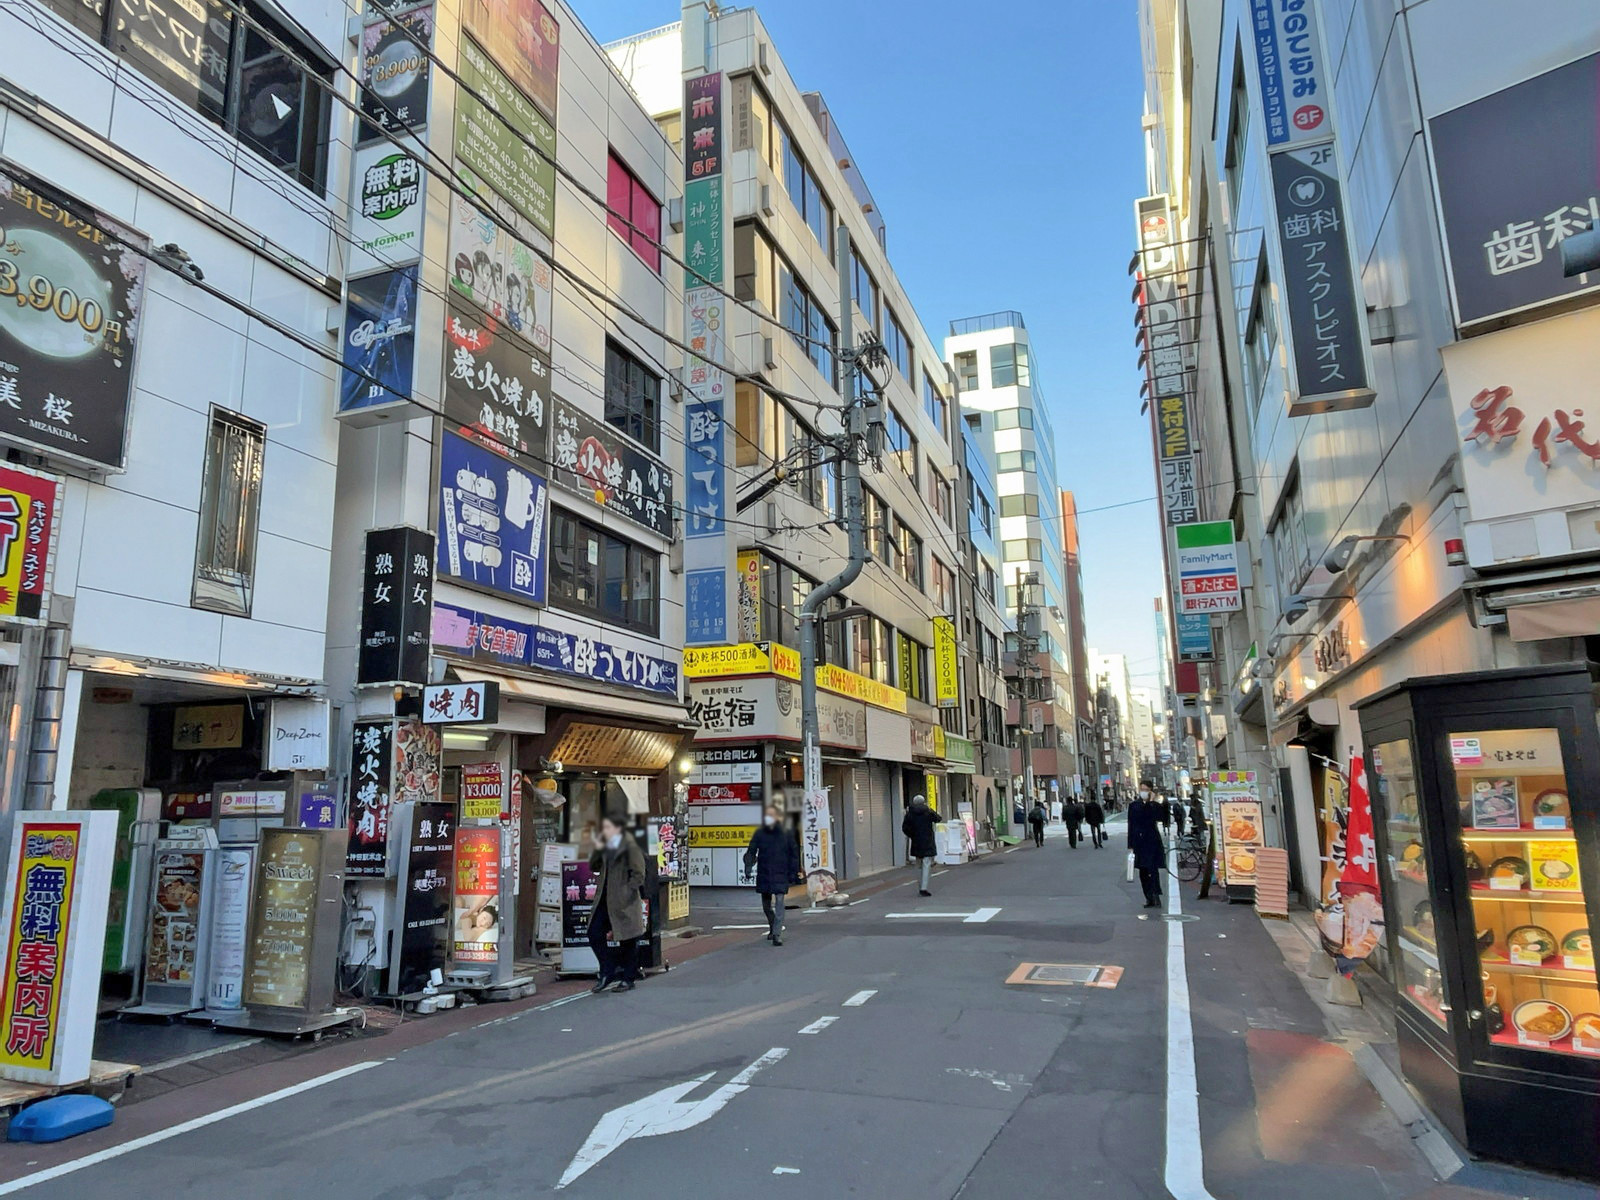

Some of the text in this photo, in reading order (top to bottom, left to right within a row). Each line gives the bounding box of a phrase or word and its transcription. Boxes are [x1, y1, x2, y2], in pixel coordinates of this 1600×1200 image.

[1296, 109, 1320, 126] 3F
[459, 140, 477, 164] TEL
[1310, 148, 1333, 166] 2F
[365, 158, 419, 194] 無料
[362, 185, 418, 217] 案内所
[690, 201, 706, 218] 神
[1283, 207, 1340, 239] 歯科
[691, 240, 706, 259] 来
[1144, 241, 1178, 332] DVD
[1302, 241, 1346, 384] アスクレピオス
[452, 316, 482, 350] 和牛
[450, 346, 544, 429] 炭火焼肉
[29, 417, 79, 444] MIZAKURA
[1160, 398, 1188, 457] 受付2F
[1464, 385, 1600, 469] 名代
[555, 429, 643, 511] 炭火焼肉
[1164, 463, 1180, 509] コイン
[1171, 510, 1194, 523] 5F
[22, 499, 48, 591] キャバクラ・スナック
[1181, 552, 1233, 565] FamilyMart
[372, 552, 395, 606] 熟女
[411, 553, 430, 606] 熟女
[514, 557, 532, 588] 酔
[1183, 577, 1237, 593] 酒・たばこ
[1185, 596, 1238, 611] 銀行ATM
[700, 648, 758, 663] 乾杯500酒場
[760, 643, 769, 652] 2F
[428, 687, 481, 720] 焼肉
[691, 696, 758, 730] 徳福
[276, 727, 322, 741] DeepZone
[291, 754, 306, 764] 5F
[355, 725, 381, 839] 炭火焼肉
[466, 783, 501, 797] ¥3,000
[319, 806, 332, 824] 泉
[470, 806, 498, 817] ¥3,000
[419, 819, 449, 839] 熟女
[265, 862, 314, 880] Sweet
[6, 865, 66, 1059] 無料案内所
